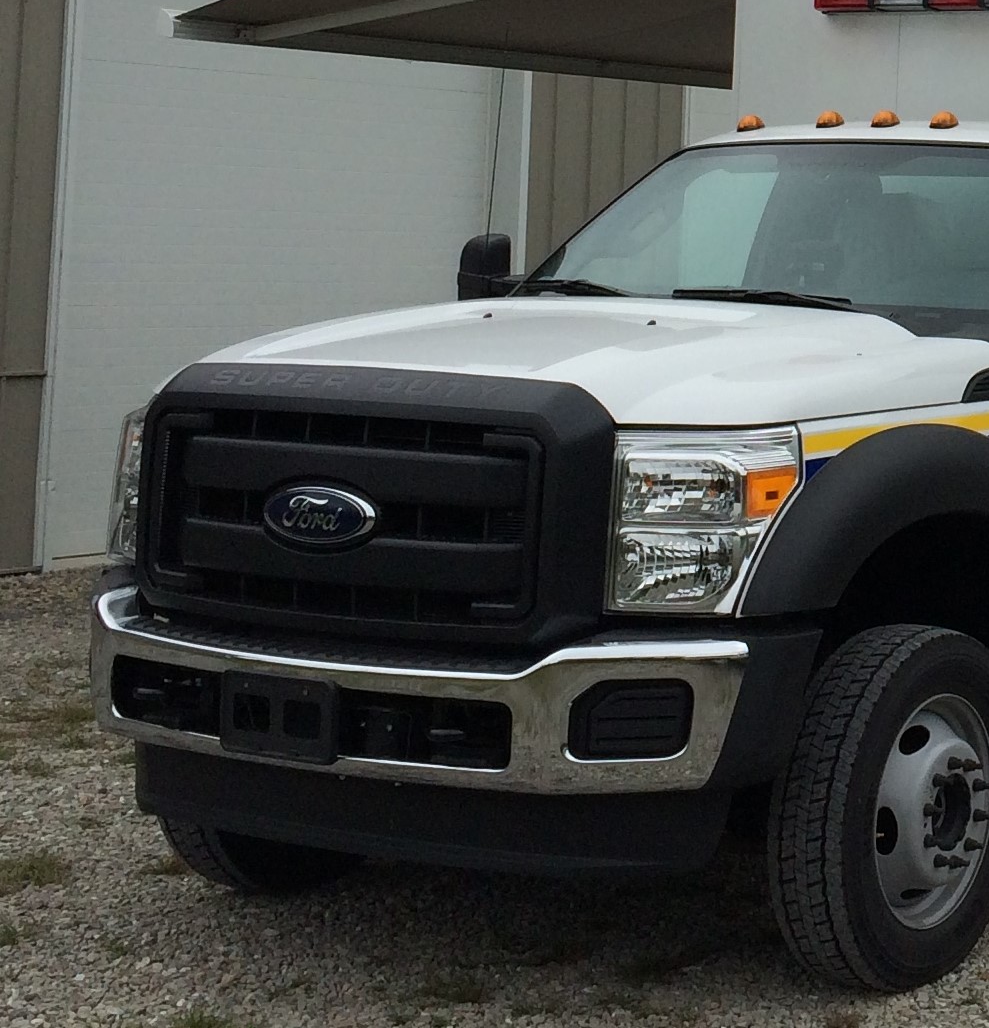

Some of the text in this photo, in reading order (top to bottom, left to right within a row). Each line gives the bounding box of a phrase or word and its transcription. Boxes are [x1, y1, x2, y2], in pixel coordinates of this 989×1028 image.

[210, 368, 509, 398] SUPER DUTY
[281, 494, 343, 531] Ford
